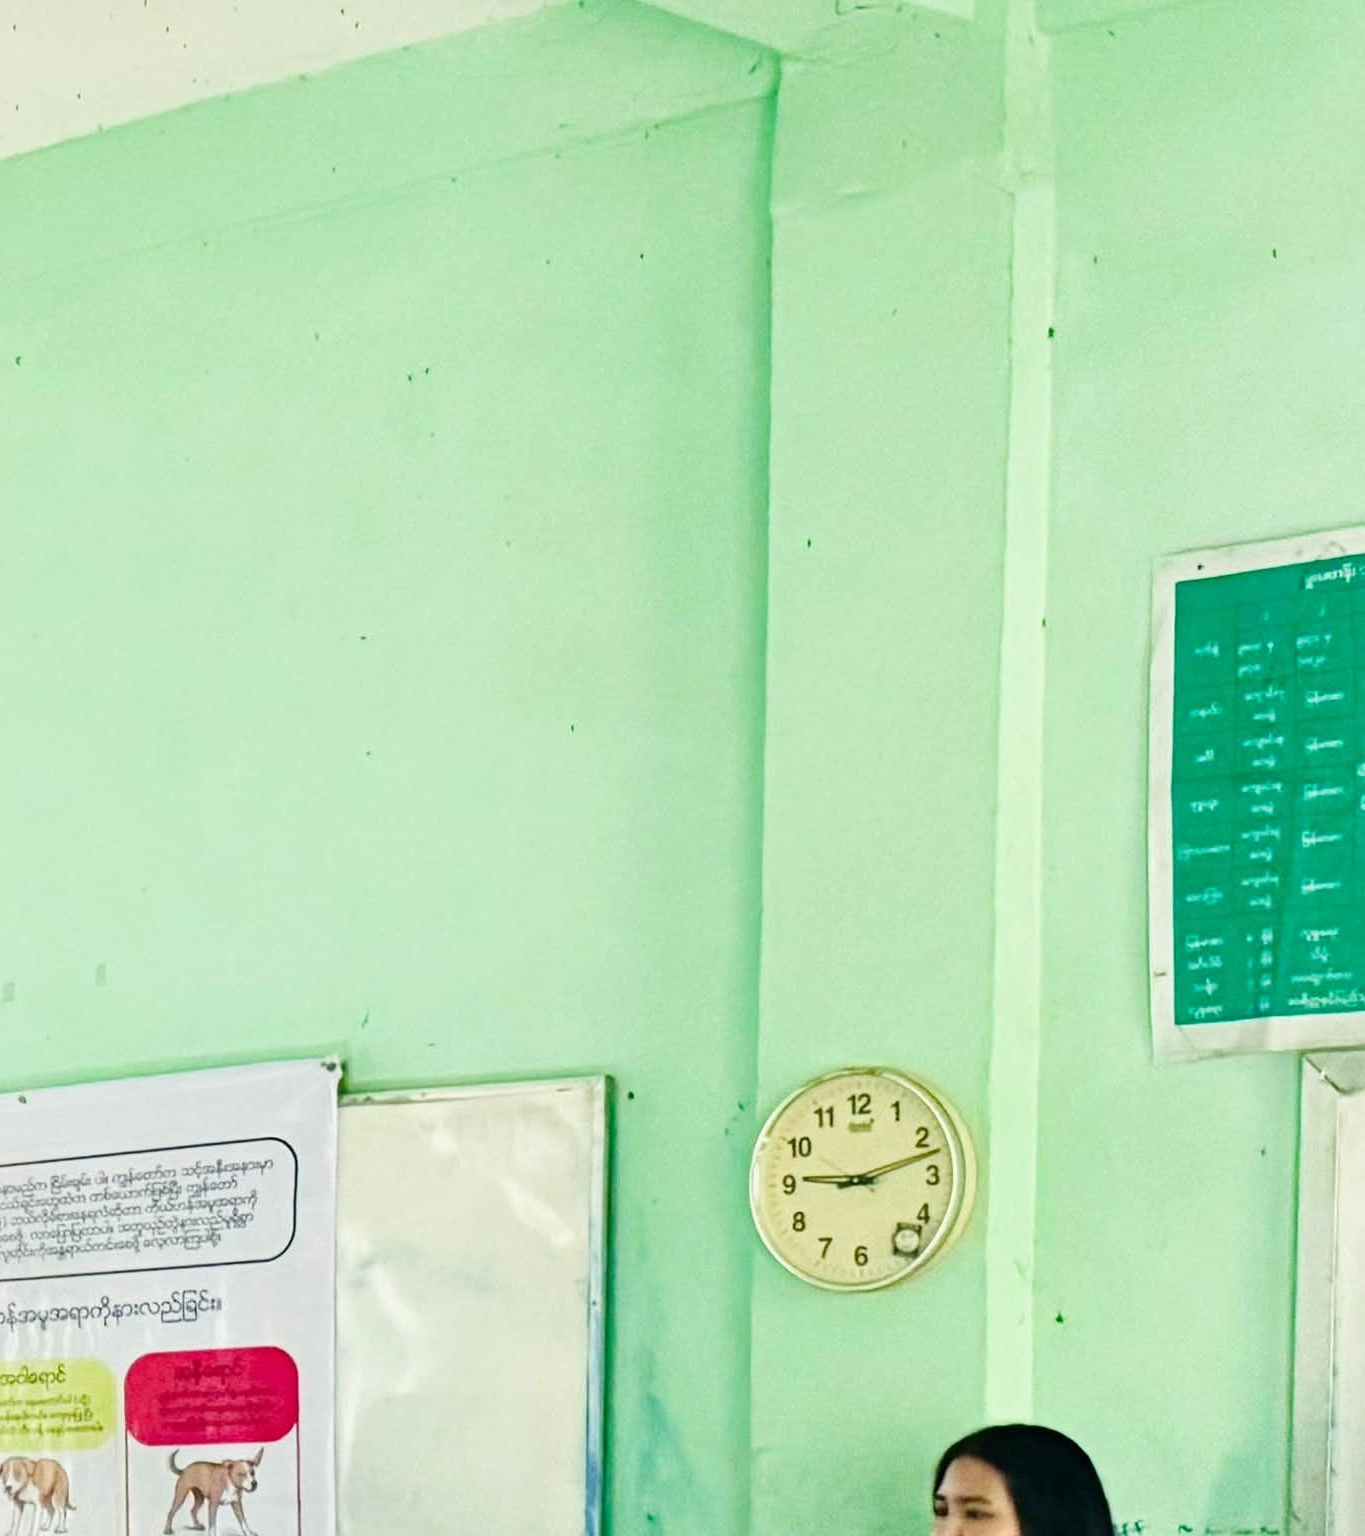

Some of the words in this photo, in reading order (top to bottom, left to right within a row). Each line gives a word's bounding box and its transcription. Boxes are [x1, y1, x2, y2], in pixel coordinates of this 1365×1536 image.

[847, 1093, 871, 1115] 12
[891, 1101, 900, 1121] 1
[814, 1106, 834, 1128] 11
[787, 1136, 812, 1158] 10
[915, 1127, 930, 1148] 2
[783, 1175, 796, 1195] 9
[926, 1165, 940, 1186] 3
[792, 1211, 806, 1232] 8
[917, 1203, 930, 1224] 4
[819, 1237, 832, 1259] 7
[854, 1246, 868, 1266] 6
